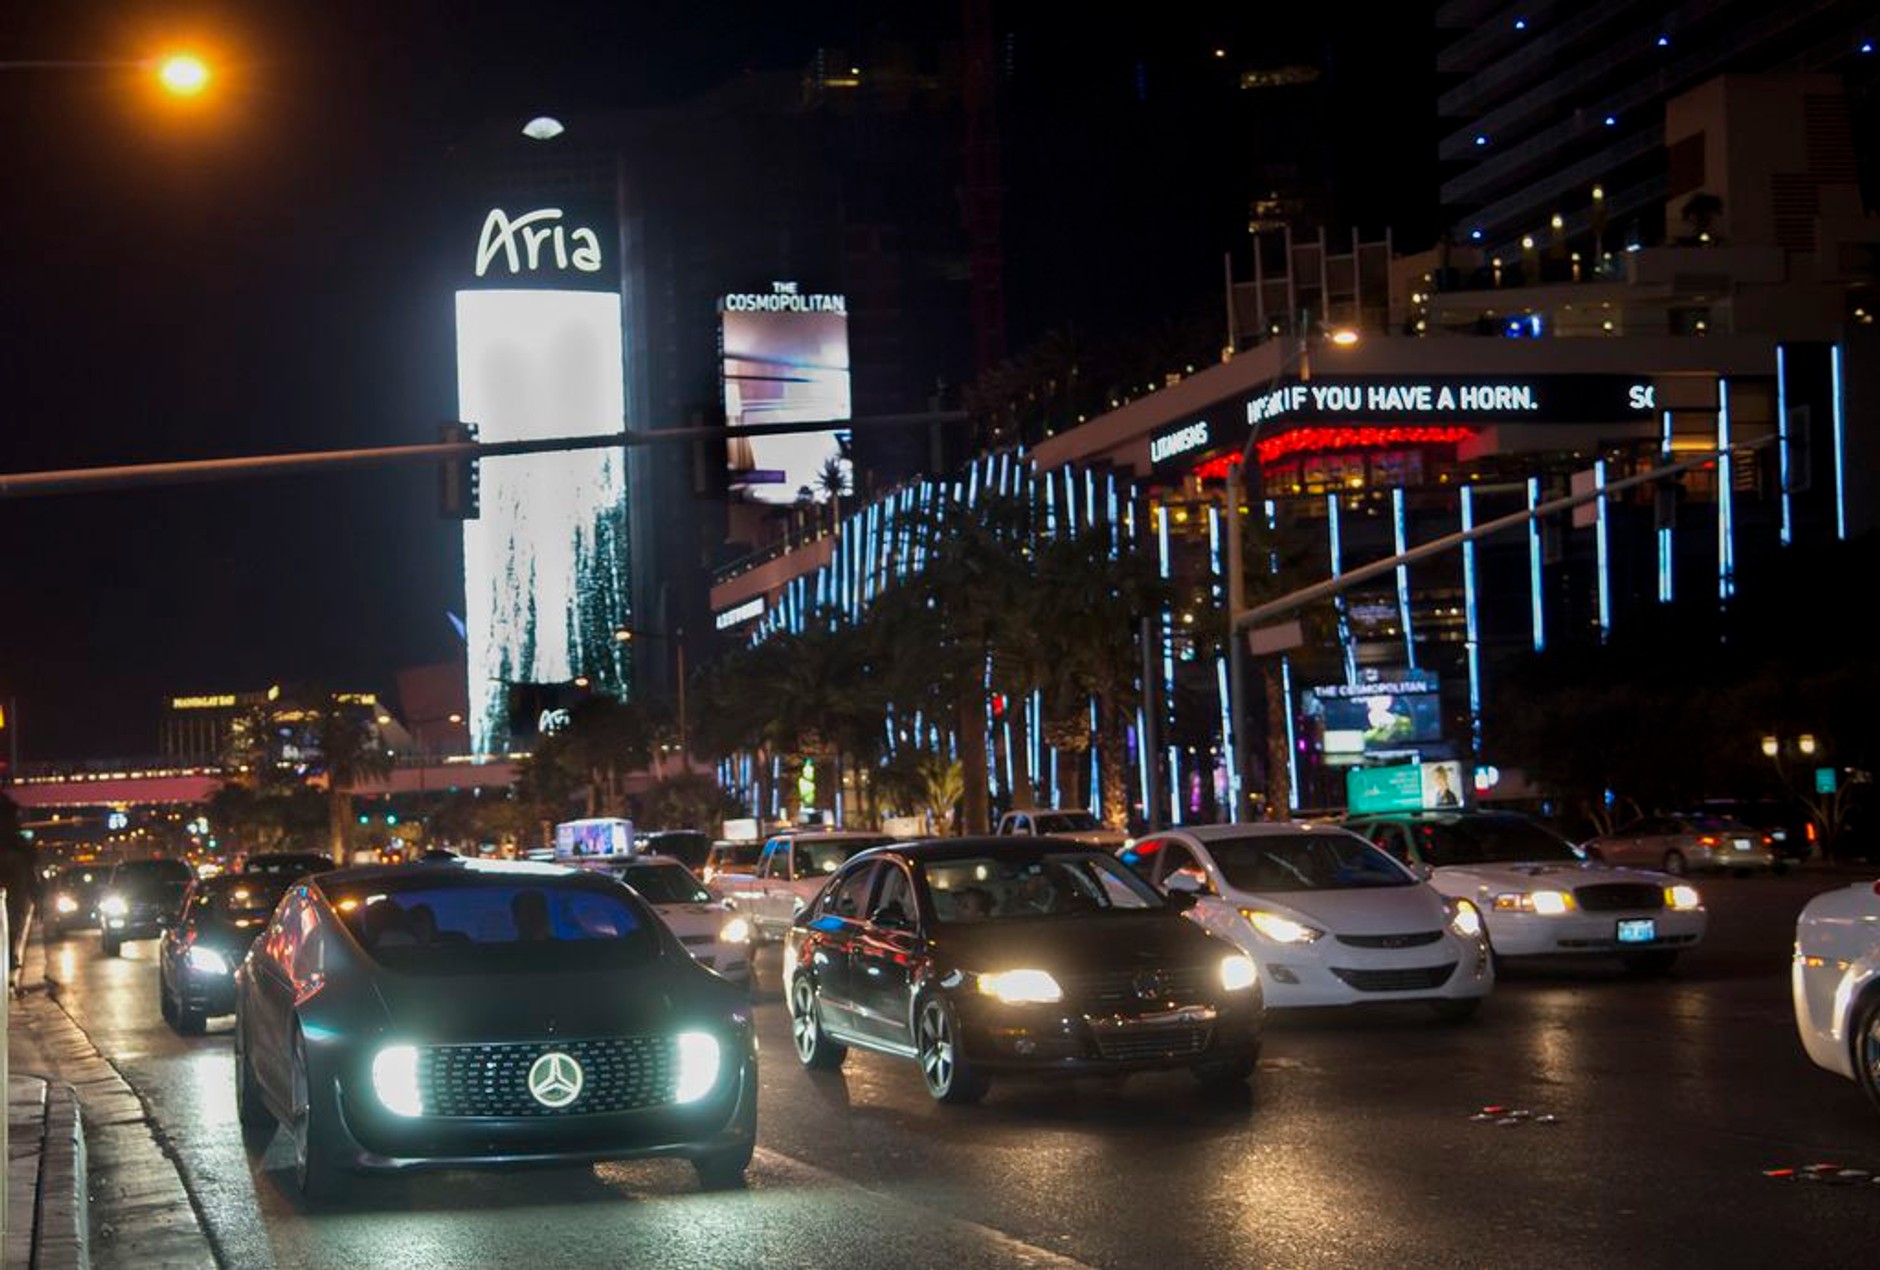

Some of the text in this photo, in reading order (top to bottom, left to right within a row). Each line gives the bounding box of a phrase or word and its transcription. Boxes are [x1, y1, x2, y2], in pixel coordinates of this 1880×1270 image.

[475, 208, 601, 277] Aria
[772, 281, 798, 293] THE
[725, 294, 846, 312] COSMOPOLITAN
[1284, 387, 1308, 411] IF
[1311, 387, 1360, 411] YOU
[1367, 387, 1432, 410] HAVE
[1436, 386, 1456, 410] A
[1460, 386, 1538, 410] HORN.
[1314, 685, 1337, 698] THE
